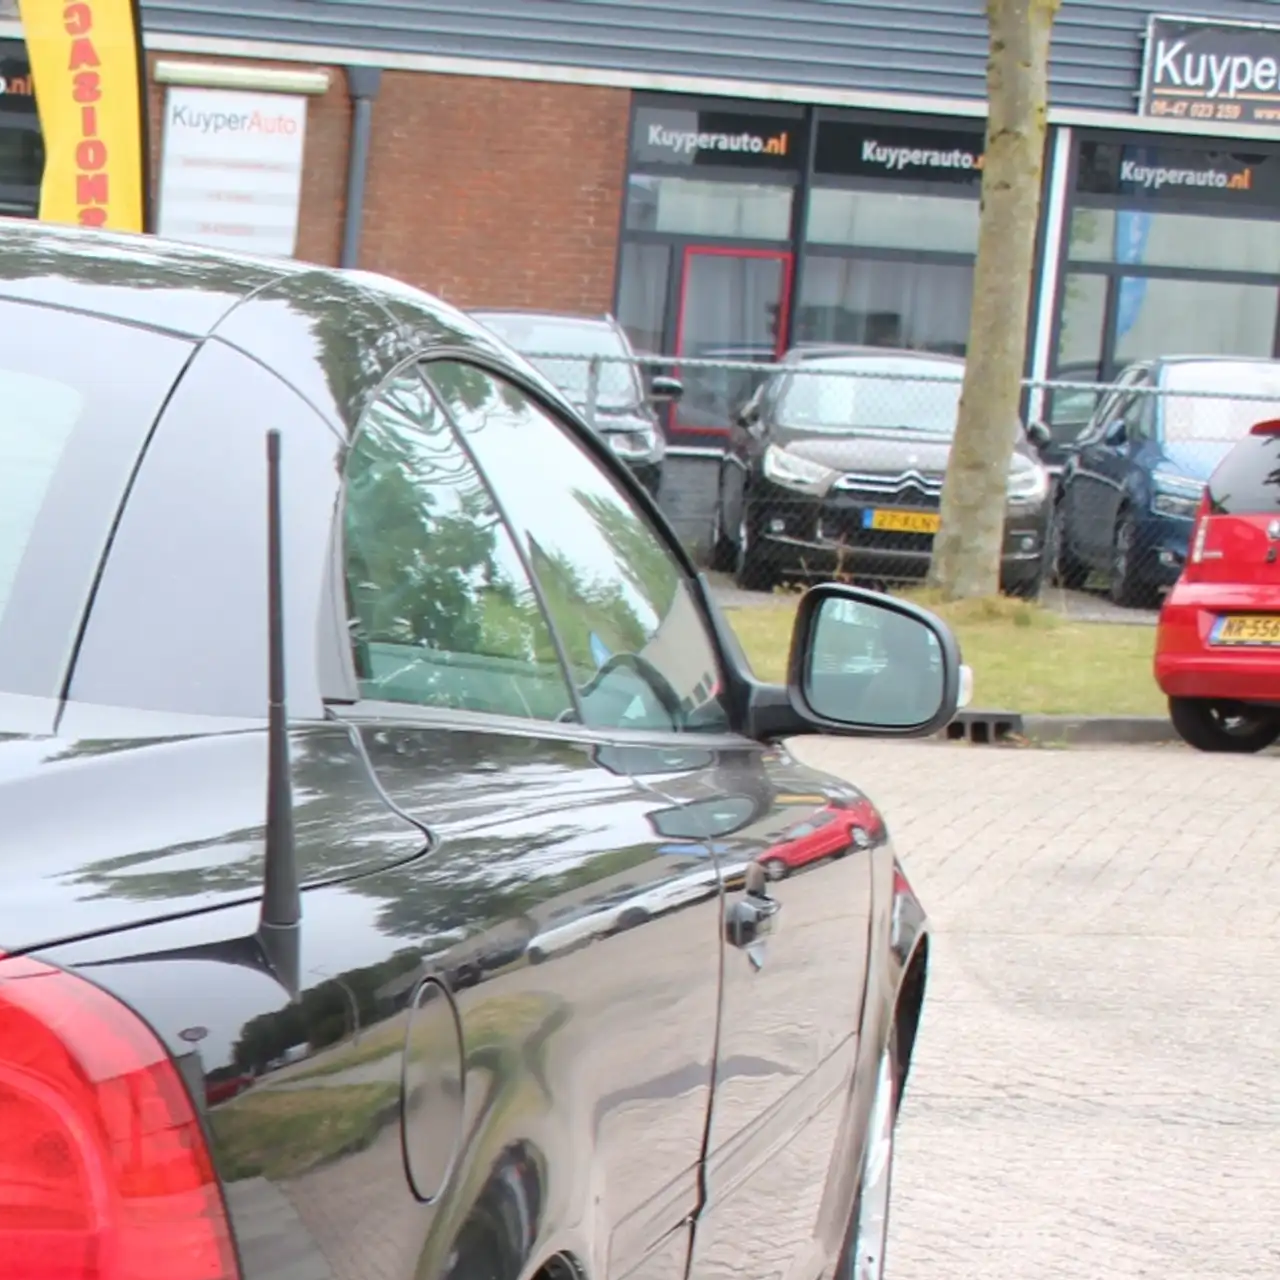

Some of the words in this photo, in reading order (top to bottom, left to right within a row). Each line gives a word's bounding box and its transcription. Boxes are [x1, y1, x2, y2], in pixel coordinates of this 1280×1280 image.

[1153, 40, 1280, 98] Kuype
[171, 103, 297, 135] KuyperAuto
[647, 124, 789, 157] Kuyperauto.nl
[1120, 159, 1254, 190] Kuyperauto.nl
